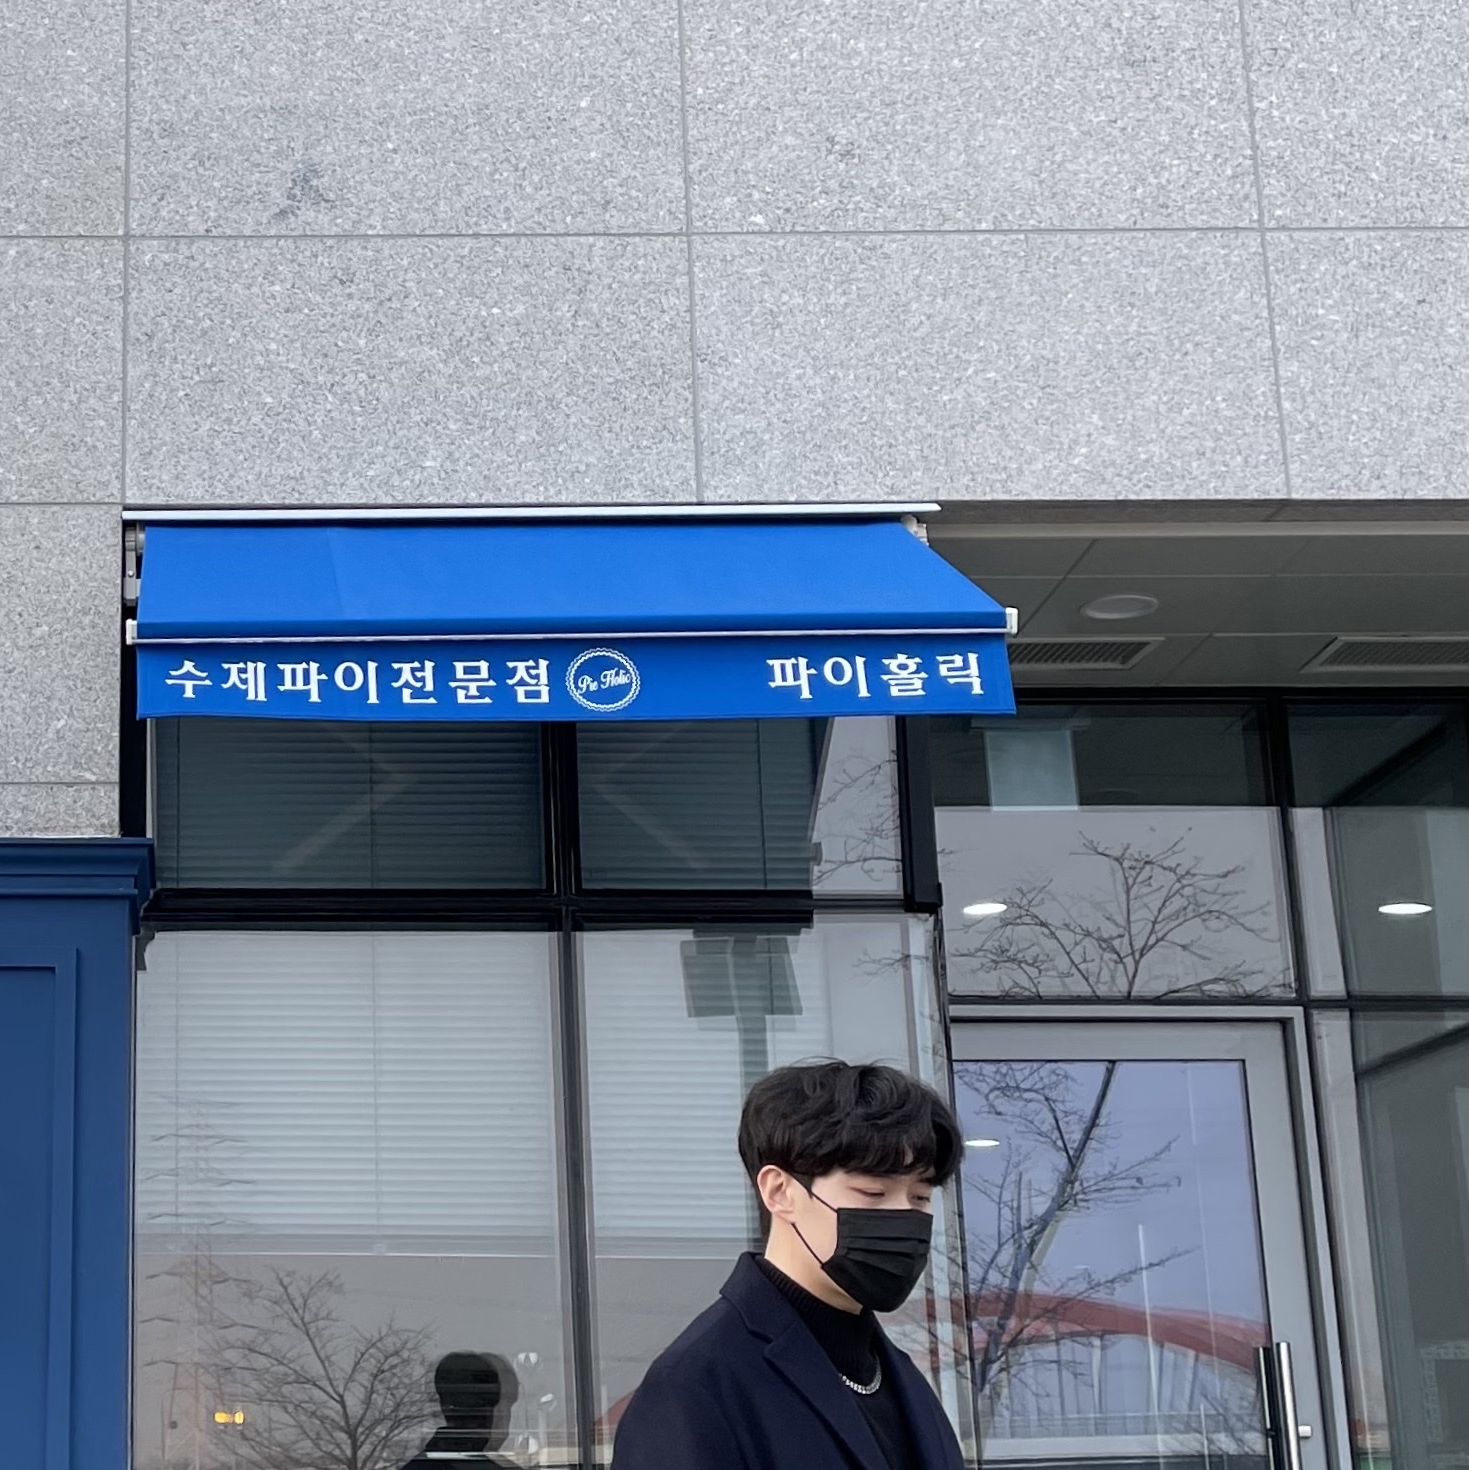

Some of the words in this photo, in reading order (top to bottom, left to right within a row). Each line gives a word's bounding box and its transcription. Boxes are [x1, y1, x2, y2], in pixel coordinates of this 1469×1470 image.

[164, 657, 550, 705] 수제파이전문점
[577, 675, 598, 694] Pie
[600, 667, 631, 689] Holic
[766, 652, 984, 700] 파이홀릭
